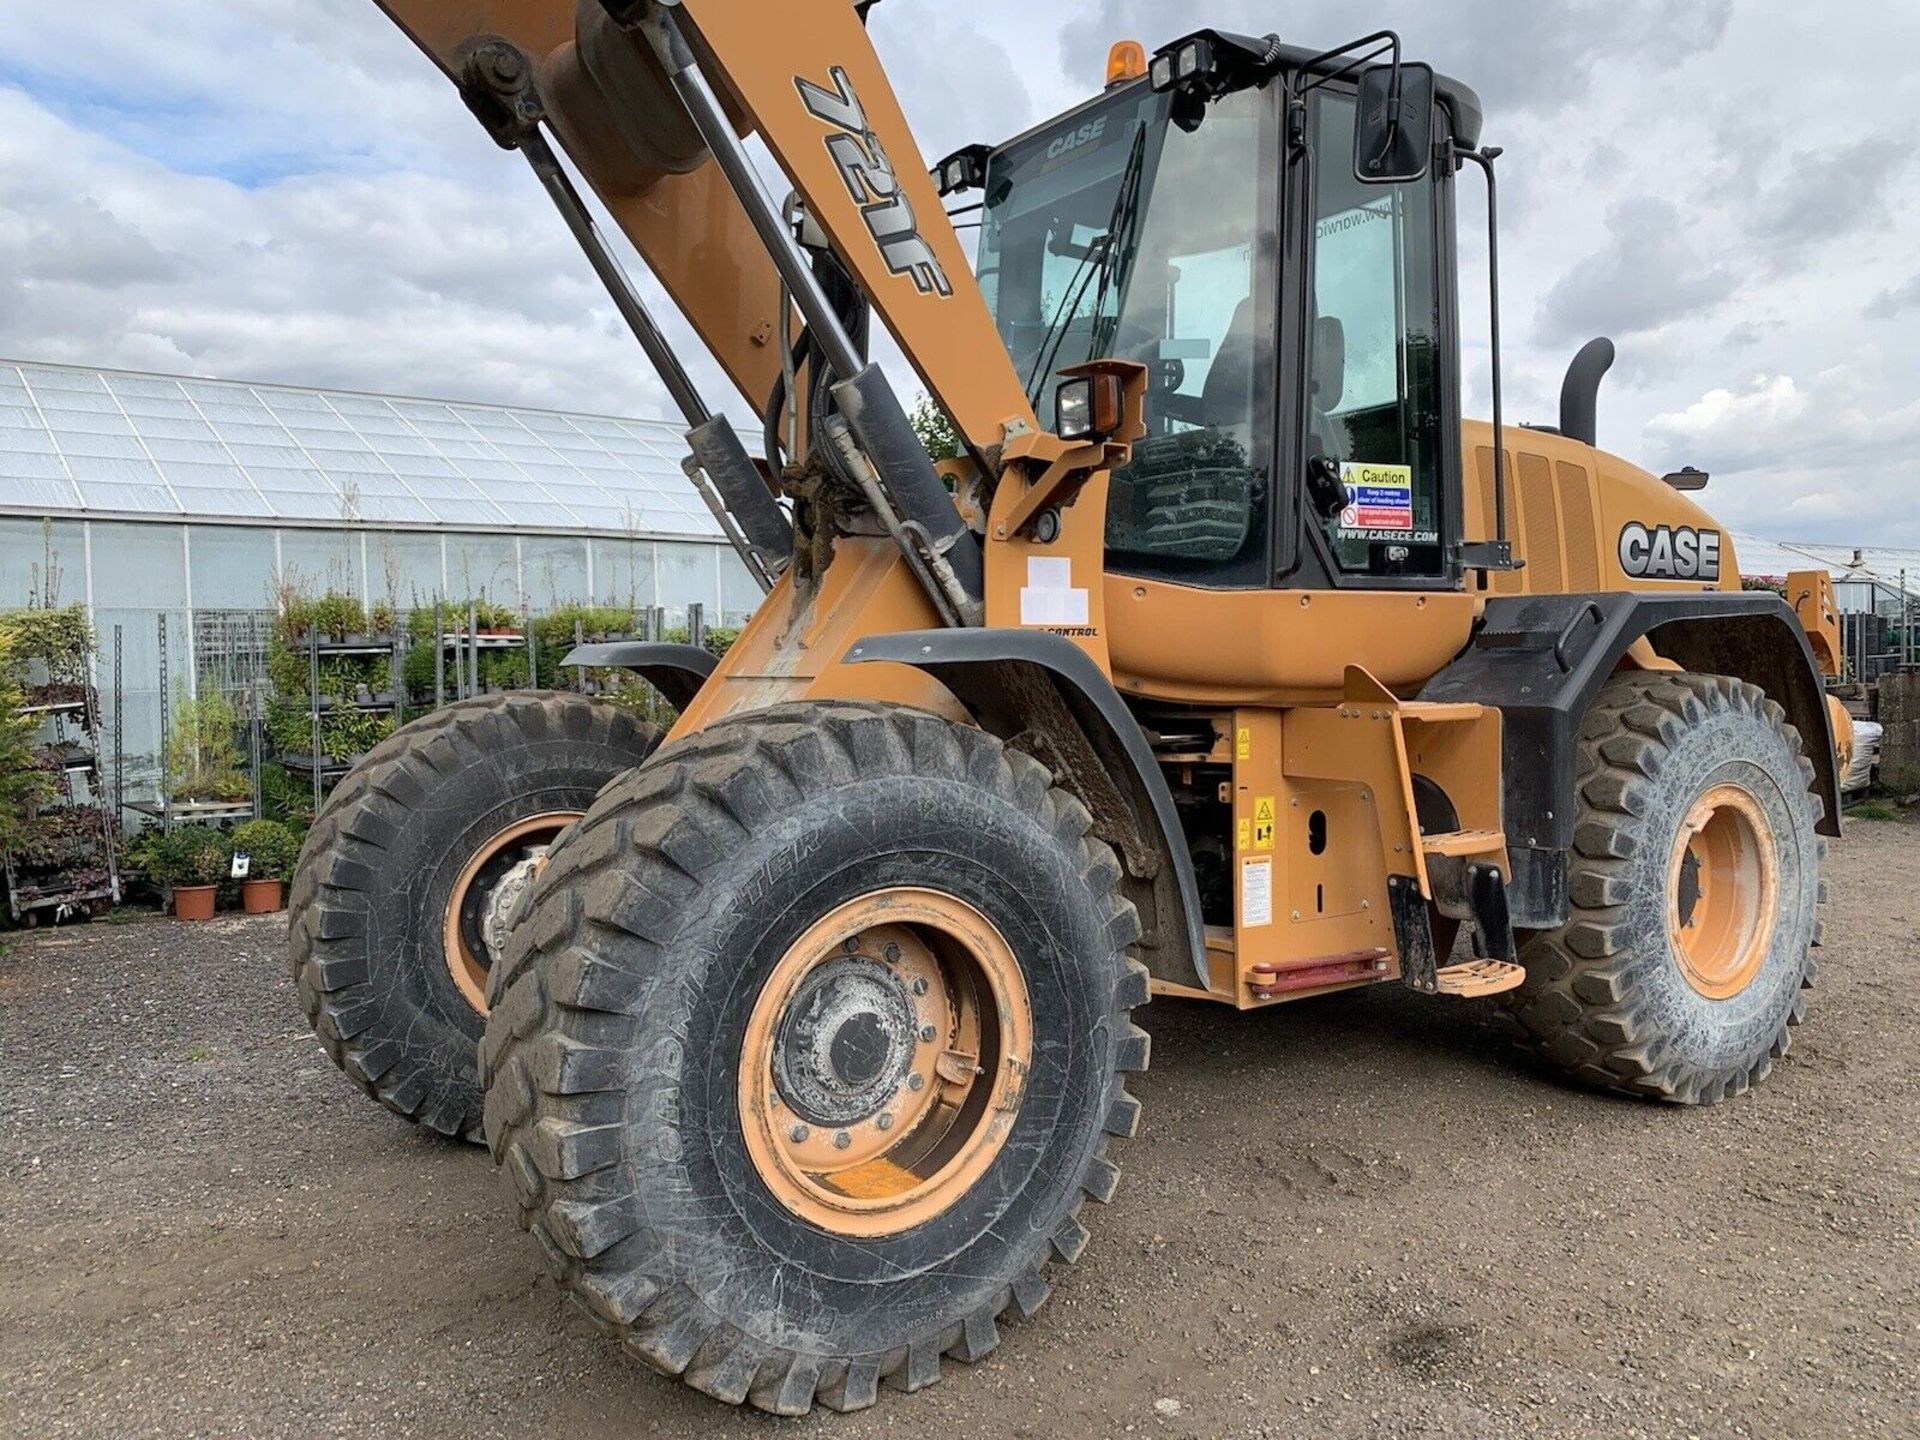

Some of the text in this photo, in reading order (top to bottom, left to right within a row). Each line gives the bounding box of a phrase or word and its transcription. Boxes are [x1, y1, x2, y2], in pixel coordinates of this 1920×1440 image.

[1046, 115, 1108, 159] CASE
[793, 66, 953, 297] 721F
[1362, 469, 1405, 484] Caution
[1337, 528, 1438, 542] WWW.CASECE.COM
[1619, 522, 1719, 580] CASE
